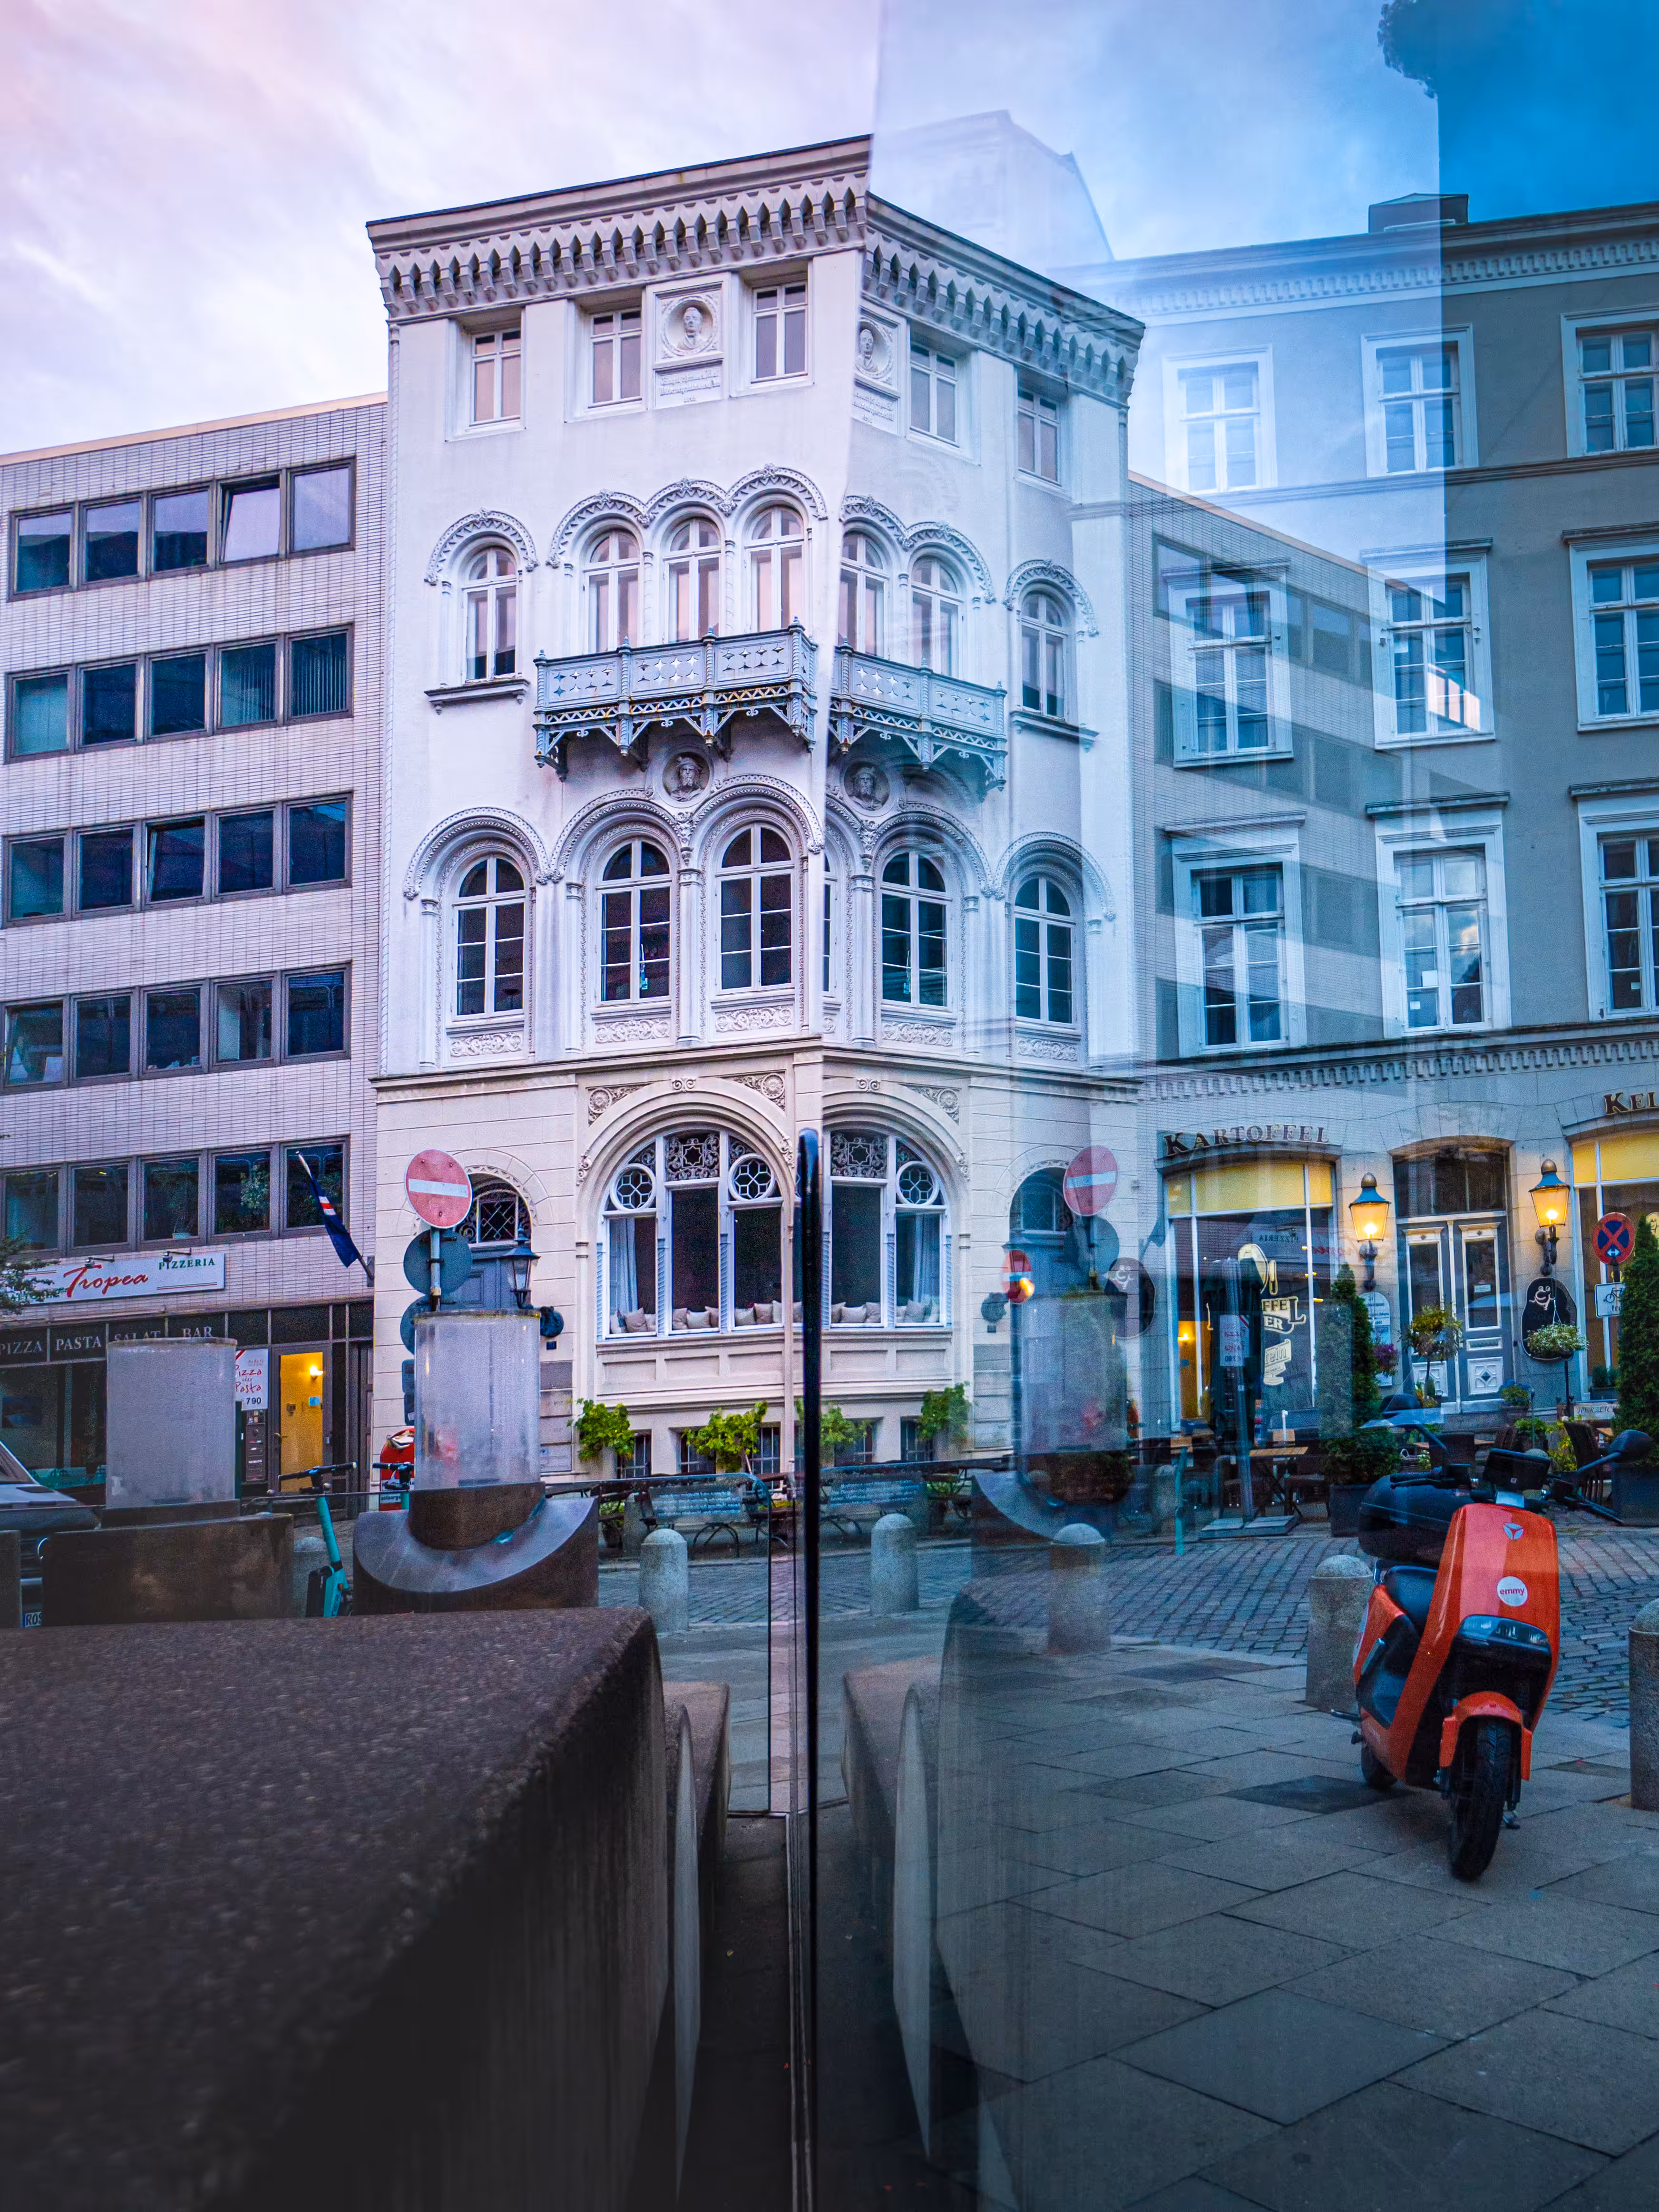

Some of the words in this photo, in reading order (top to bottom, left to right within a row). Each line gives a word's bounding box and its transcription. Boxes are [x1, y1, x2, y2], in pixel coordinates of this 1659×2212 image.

[1164, 1124, 1329, 1157] KARTOFFEL
[159, 1257, 215, 1270] PIZZERIA
[63, 1264, 149, 1297] Tropea
[0, 1341, 43, 1354] PIZZA
[56, 1336, 102, 1351] PASTA
[183, 1326, 213, 1338] BAR
[236, 1381, 261, 1393] Pasta
[1500, 1588, 1524, 1596] emmy
